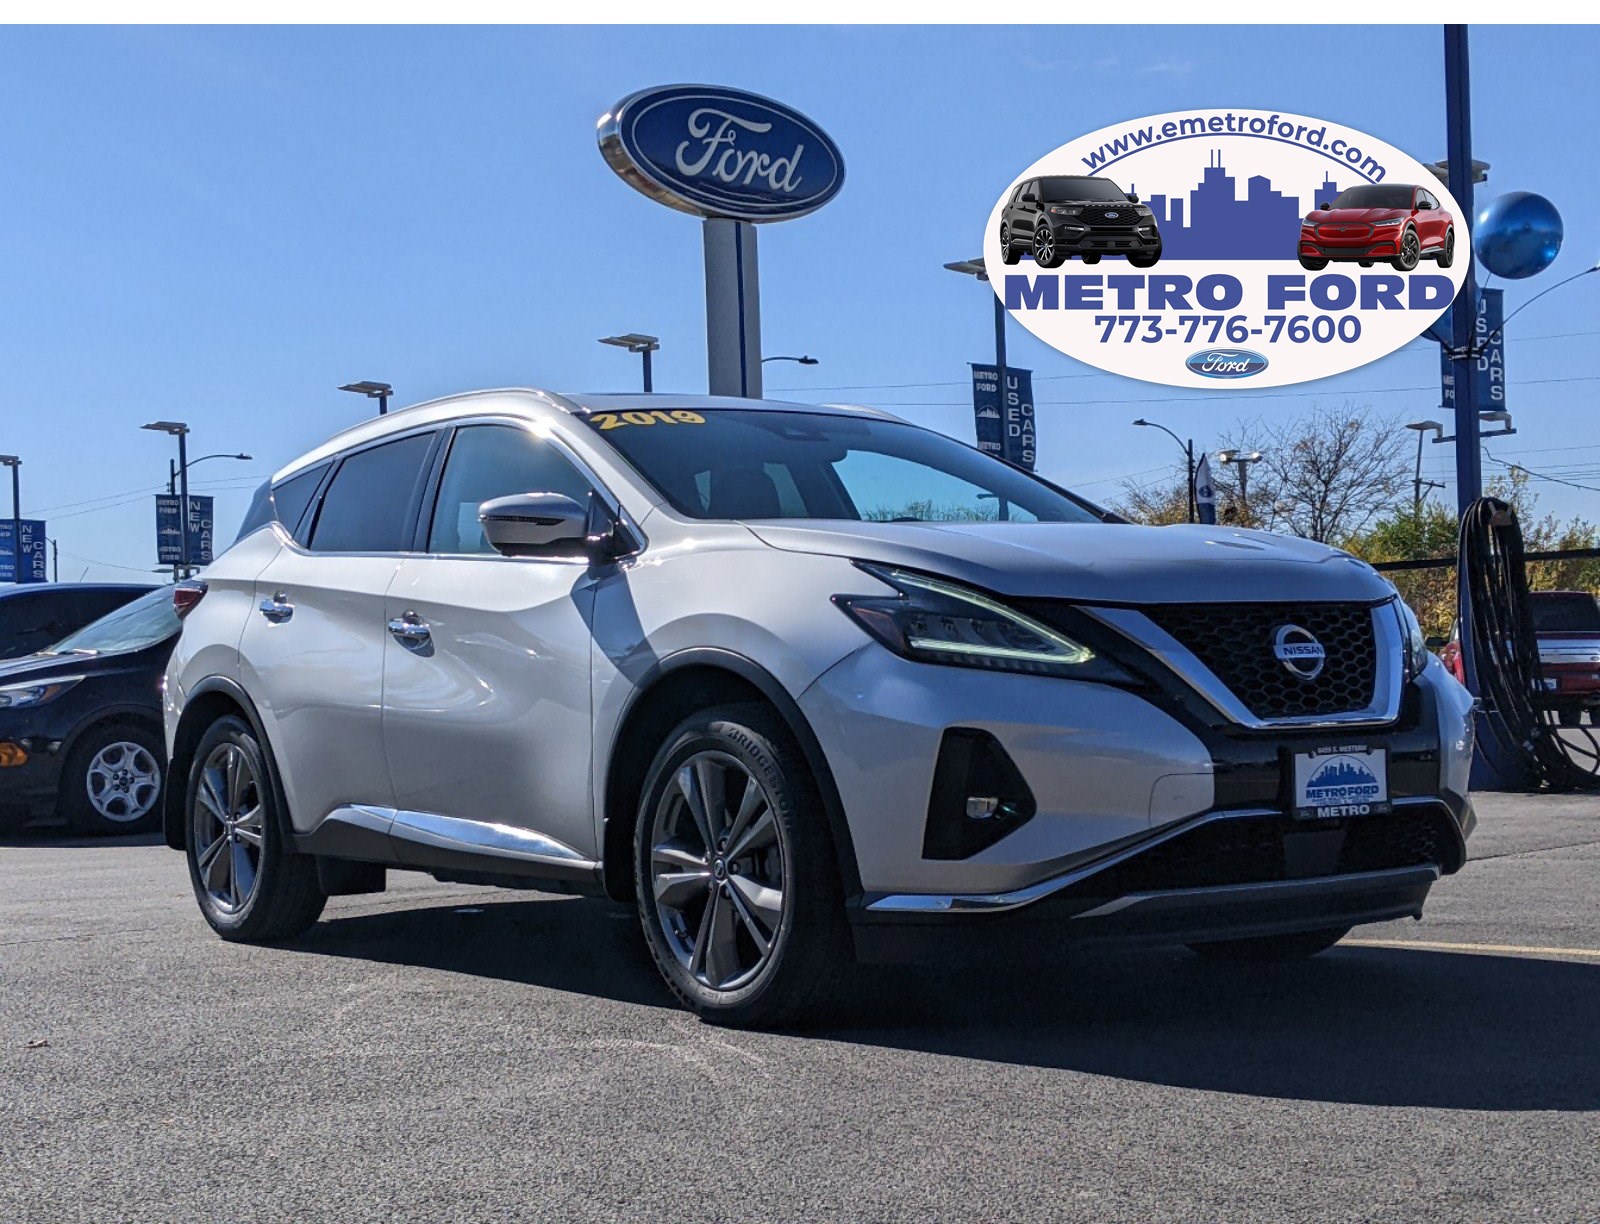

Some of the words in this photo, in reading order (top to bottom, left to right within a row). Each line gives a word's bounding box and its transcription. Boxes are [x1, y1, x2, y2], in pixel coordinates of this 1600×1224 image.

[675, 107, 805, 193] Ford
[1489, 330, 1504, 401] CARS
[976, 383, 997, 392] FORD
[590, 410, 706, 430] 2019
[1006, 375, 1021, 437] USED
[1021, 403, 1035, 463] CARS
[190, 501, 201, 533] NEW
[22, 525, 32, 554] NEW
[201, 519, 212, 561] CARS
[33, 541, 44, 579] CARS
[1283, 645, 1323, 655] NISSAN
[1317, 804, 1370, 818] METRO
